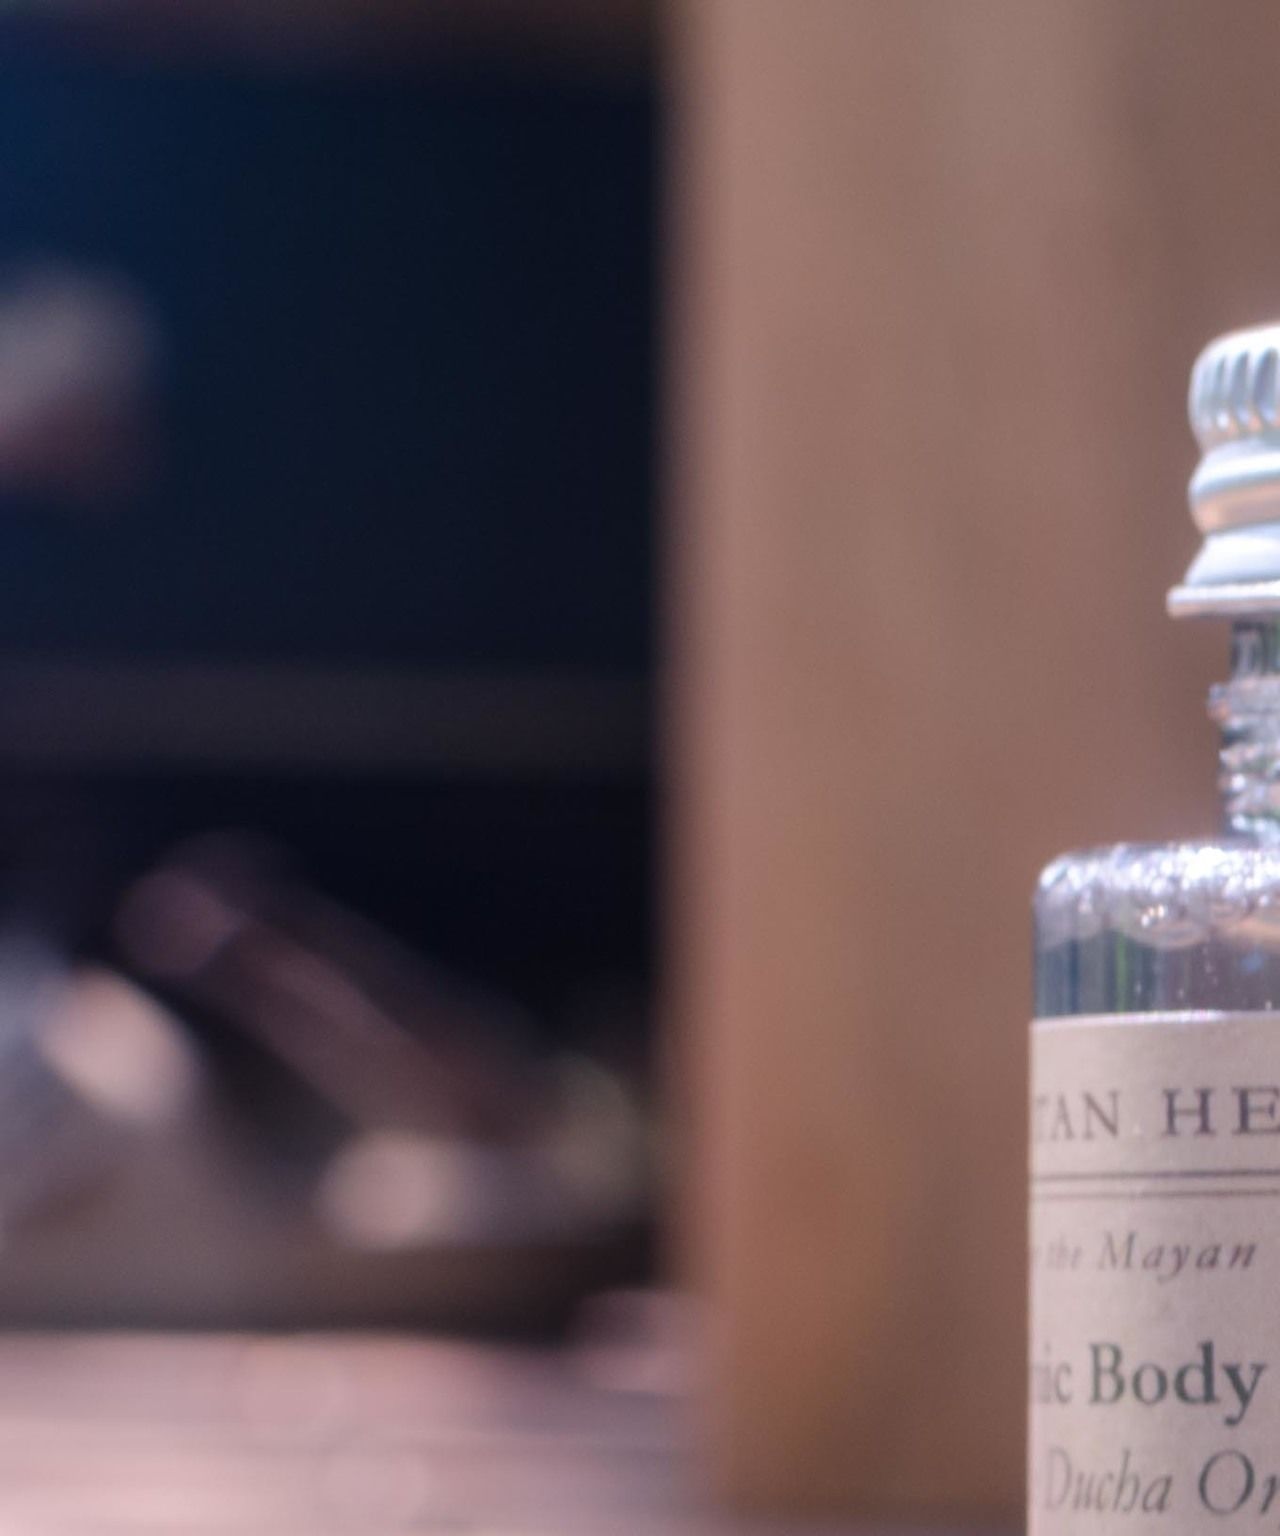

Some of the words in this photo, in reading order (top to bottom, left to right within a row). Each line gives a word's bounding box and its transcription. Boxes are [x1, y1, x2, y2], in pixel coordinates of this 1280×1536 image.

[1099, 1231, 1257, 1284] Mayan
[1088, 1340, 1267, 1426] Body
[1046, 1446, 1173, 1514] Ducha
